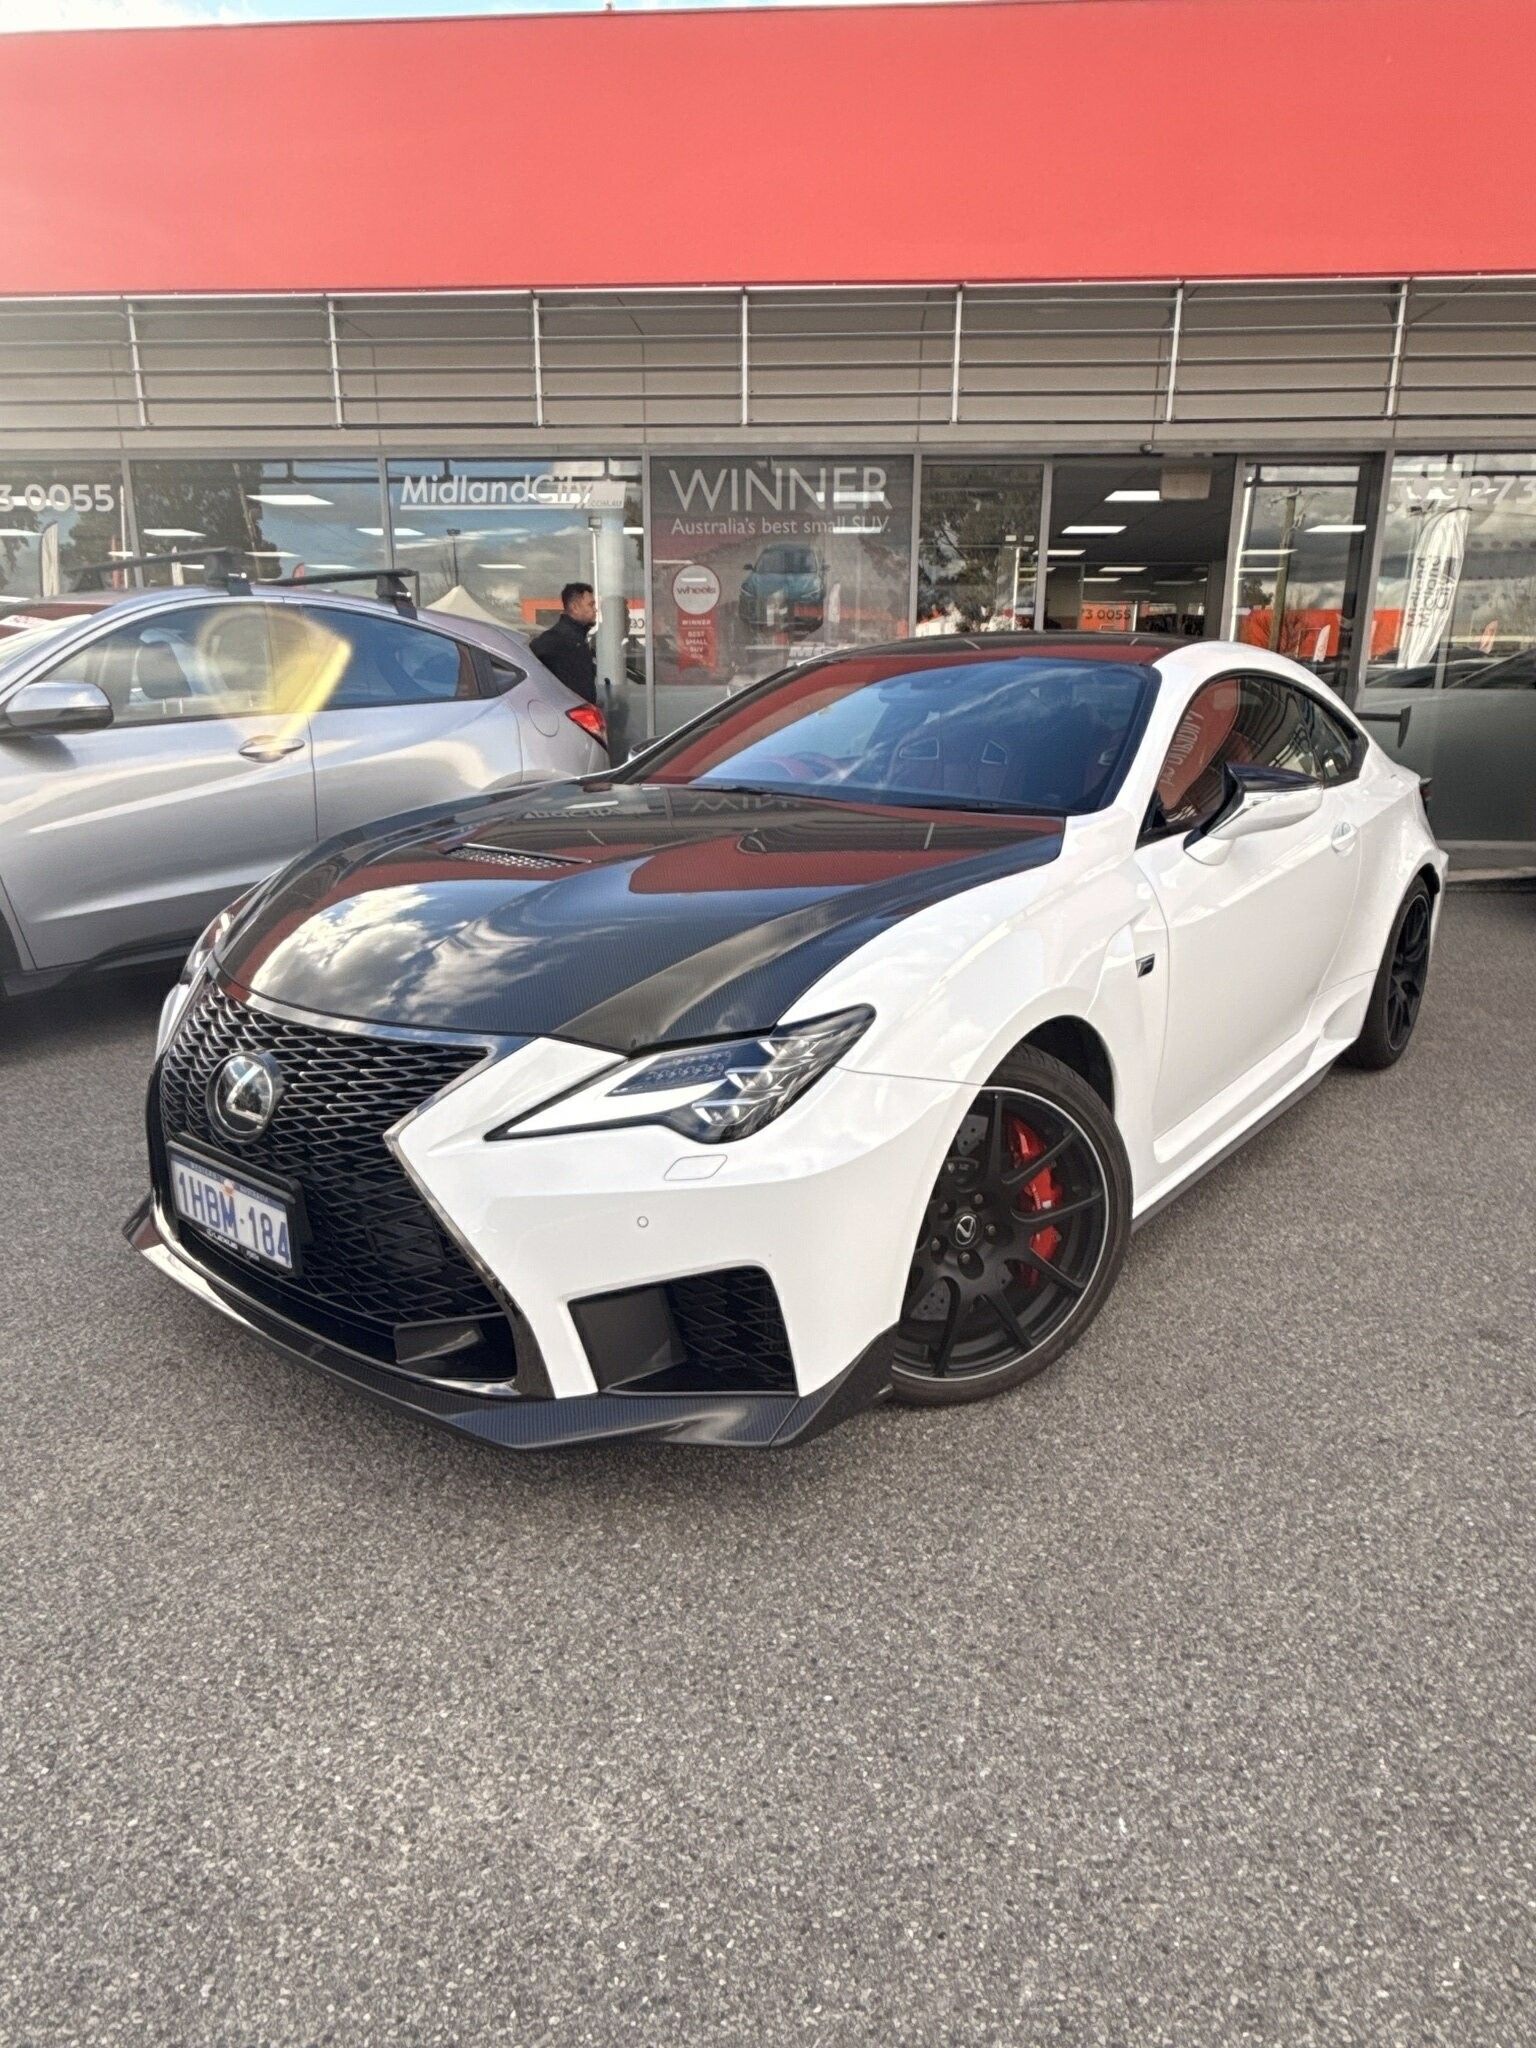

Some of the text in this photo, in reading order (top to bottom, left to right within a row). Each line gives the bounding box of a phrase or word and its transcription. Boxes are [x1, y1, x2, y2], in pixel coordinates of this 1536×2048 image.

[25, 484, 115, 511] 0055
[401, 473, 594, 505] MidlandCity
[668, 467, 893, 511] WINNER
[671, 516, 755, 535] Australia's
[762, 518, 800, 534] best
[804, 517, 846, 534] small
[677, 586, 716, 594] wheels
